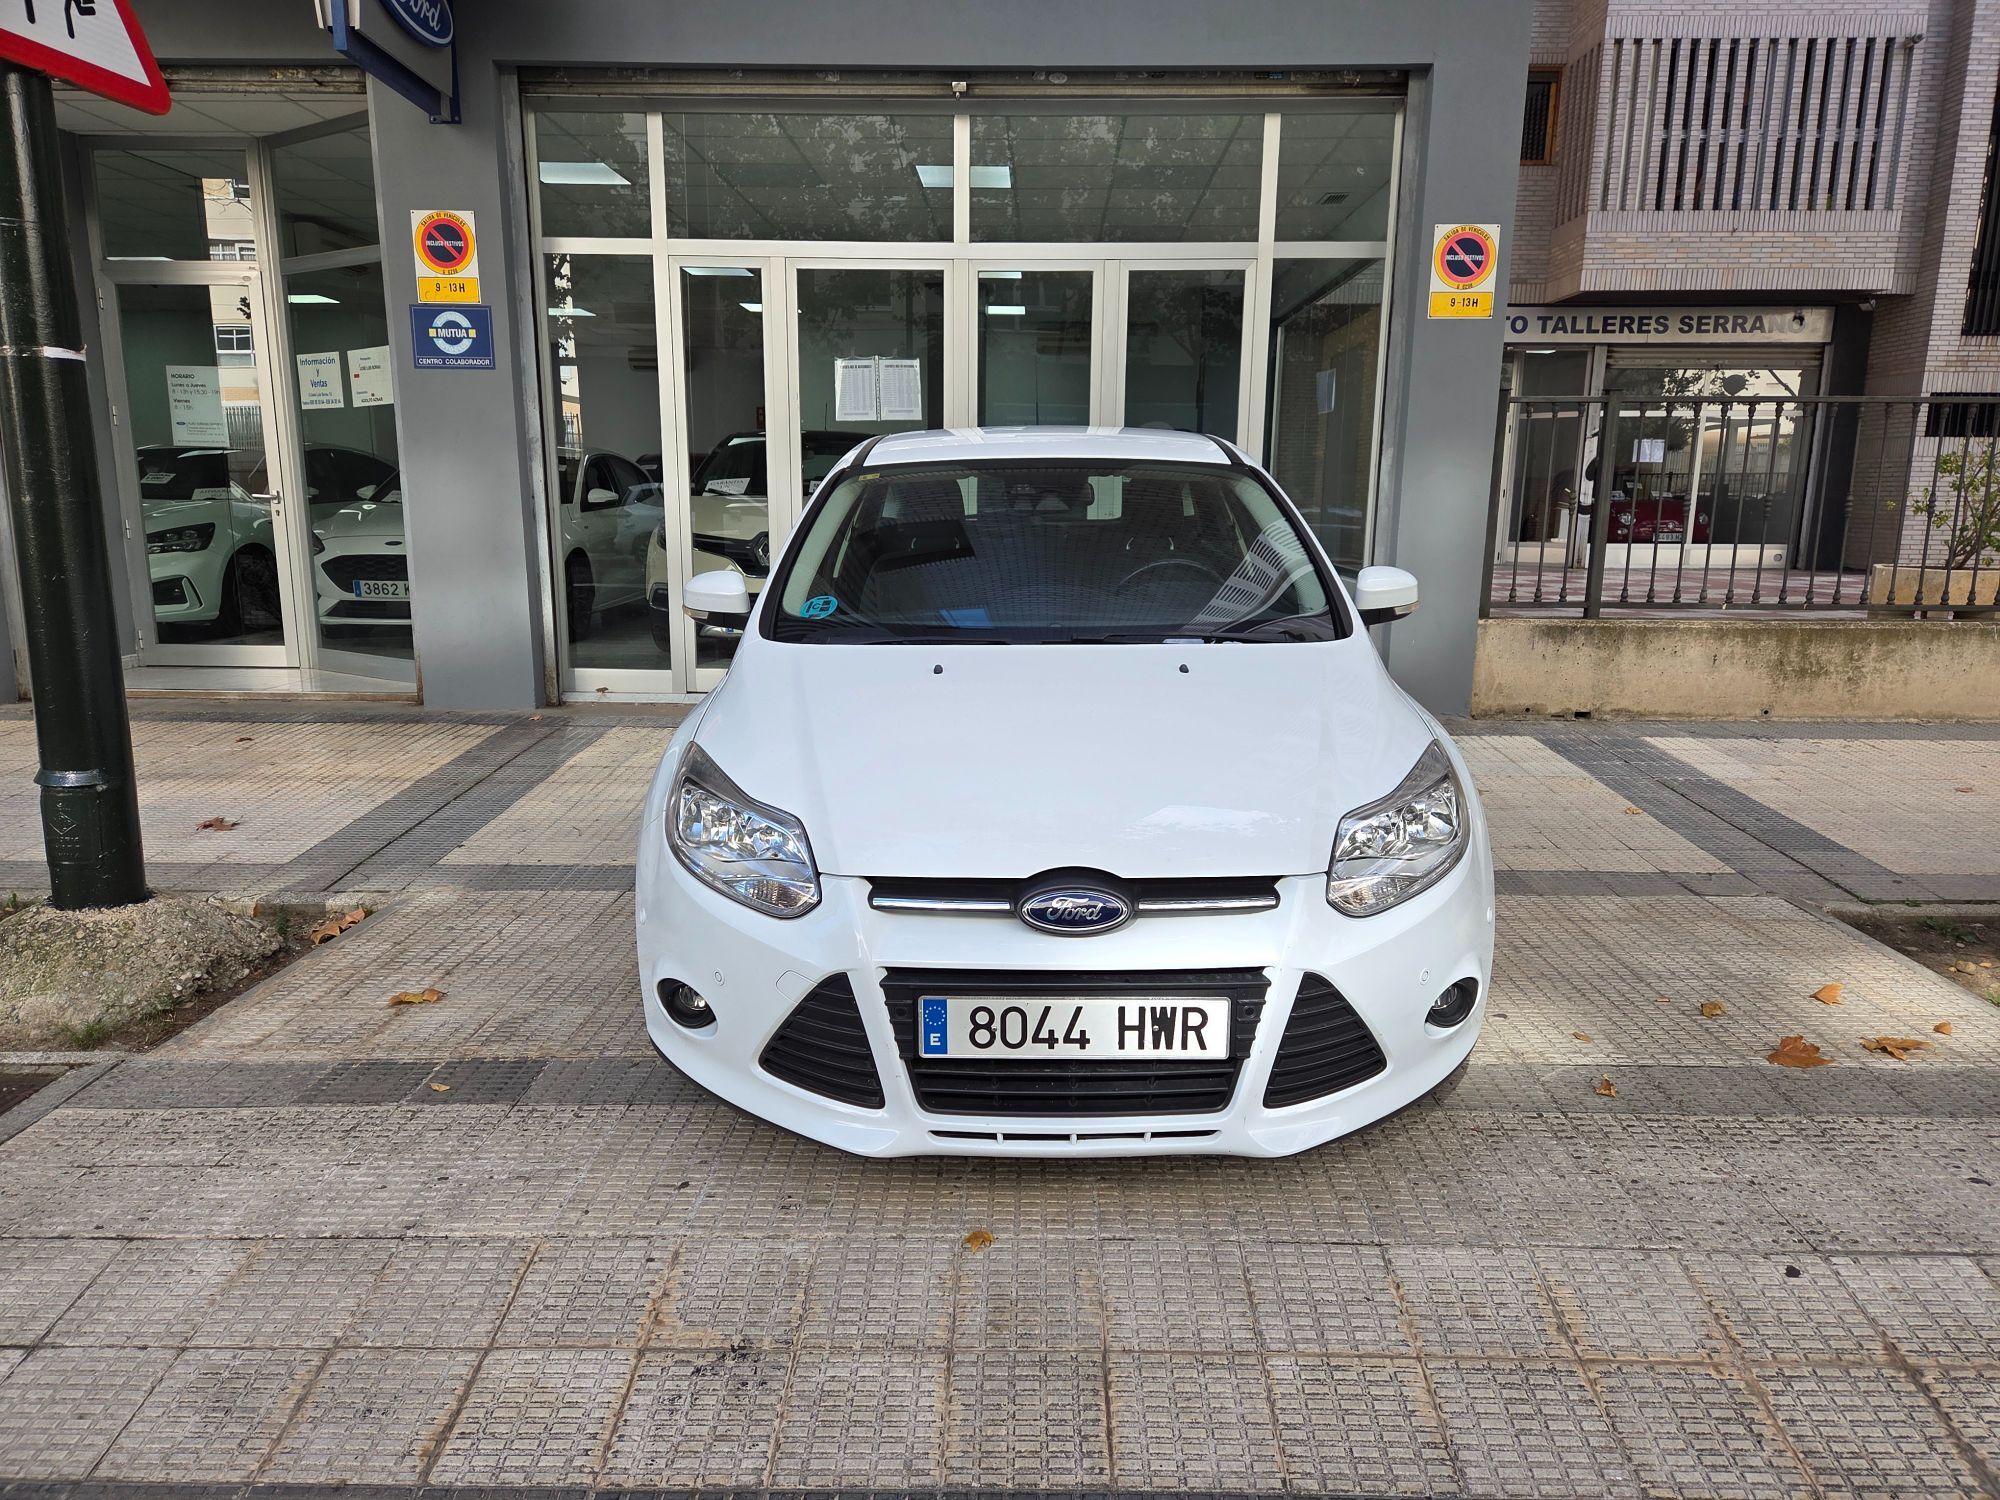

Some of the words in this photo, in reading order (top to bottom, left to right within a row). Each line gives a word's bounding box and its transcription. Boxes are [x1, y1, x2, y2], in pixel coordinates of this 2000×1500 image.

[421, 214, 435, 227] SALIDA
[443, 212, 466, 228] VEHICULOS
[1443, 228, 1460, 241] SALIDA
[1468, 226, 1491, 242] VEHICULOS
[1537, 315, 1670, 334] TALLERES
[1678, 314, 1806, 334] SERRANO
[437, 328, 467, 338] MUTUA
[300, 356, 336, 366] Información
[445, 358, 490, 366] COLABORADOR
[315, 368, 320, 377] y
[310, 379, 328, 388] Ventas
[363, 582, 400, 596] 3862
[1046, 896, 1103, 920] Ford
[930, 1033, 941, 1046] E
[968, 1005, 1091, 1050] 8044
[1117, 1005, 1209, 1050] HWR
